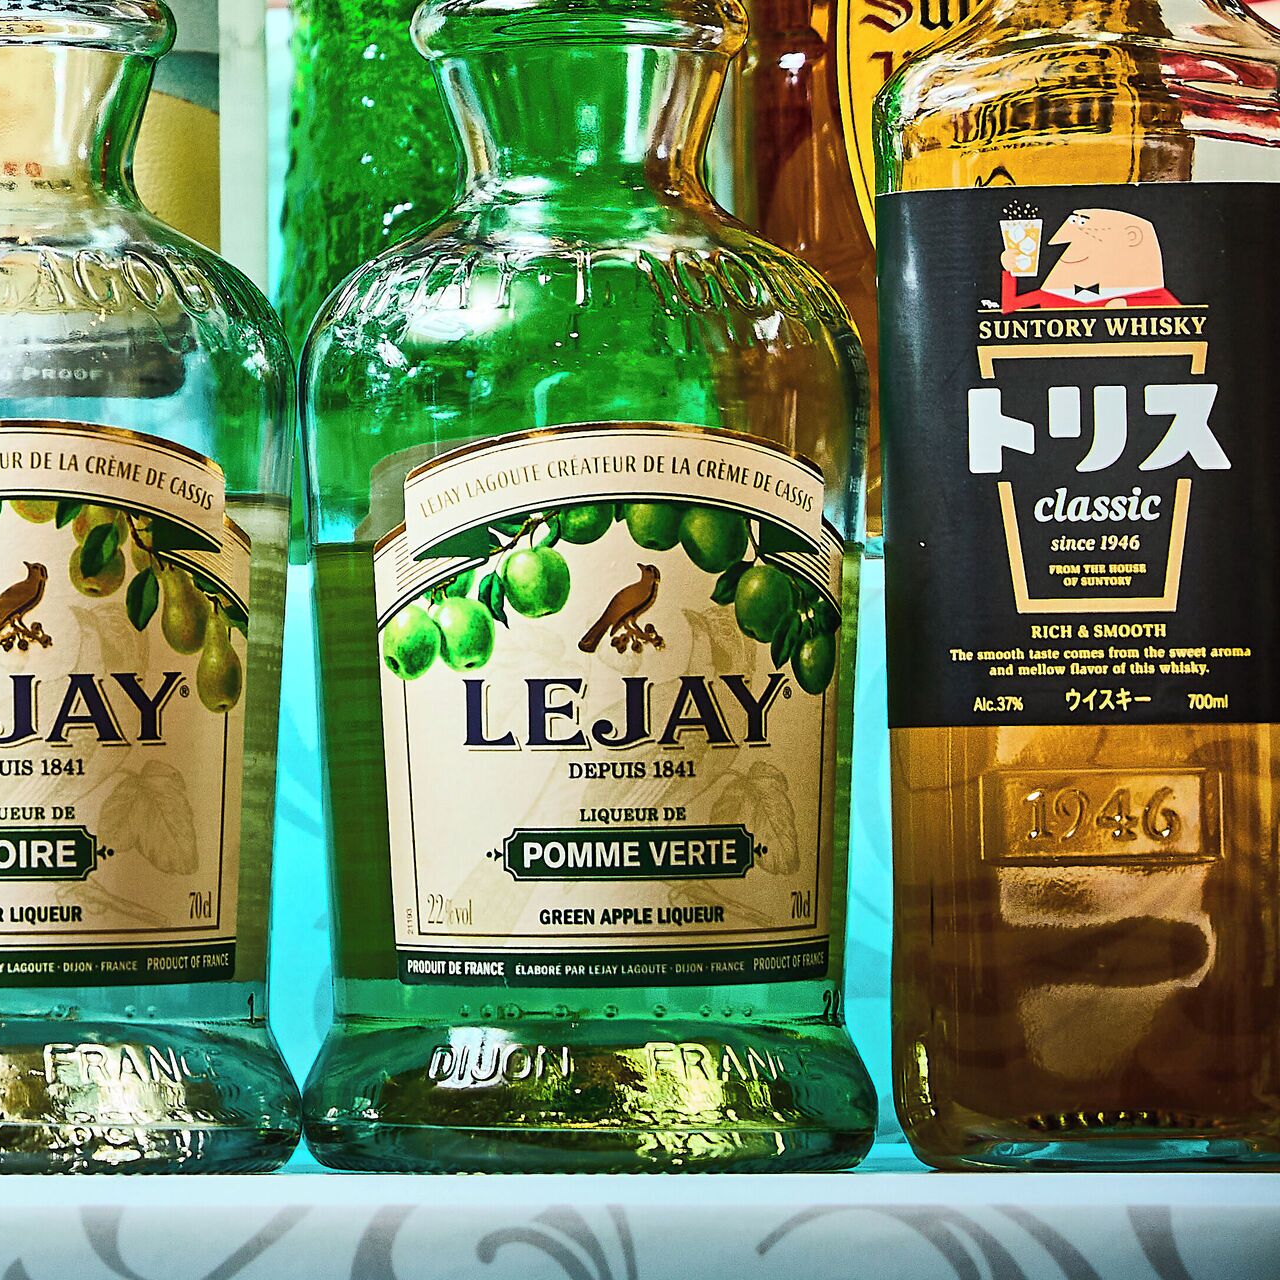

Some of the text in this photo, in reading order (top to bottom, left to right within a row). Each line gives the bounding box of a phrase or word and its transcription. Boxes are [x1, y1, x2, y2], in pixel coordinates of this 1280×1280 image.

[979, 317, 1208, 342] SUNTORY WHISKY
[968, 384, 1231, 474] トリス
[1034, 488, 1162, 522] classic
[1050, 535, 1140, 553] since 1946
[1049, 564, 1146, 574] FROM THE HOUSE
[1063, 577, 1132, 586] OF SUNTORY
[1031, 624, 1166, 639] RICH & SMOOTH
[950, 646, 1251, 662] The smooth taste comes from the sweet aroma
[989, 662, 1209, 676] and mellow flavor of this whisky.
[973, 696, 1023, 712] Alc.37%
[1065, 688, 1151, 711] ウイスキー
[1188, 693, 1229, 710] 700ml
[463, 674, 786, 747] LEJAY
[40, 759, 85, 776] 1841
[569, 761, 696, 780] DEPUIS 1841
[52, 807, 75, 821] DE
[580, 807, 687, 824] LIQUEUR DE
[1022, 785, 1182, 842] 1946
[523, 838, 737, 869] POMME VERTE
[189, 891, 212, 920] 70cl
[9, 906, 83, 923] LIQUEUR
[540, 907, 725, 926] GREEN APPLE LIQUEUR
[7, 961, 55, 974] LAGOUTE
[63, 961, 92, 973] DIJON
[101, 959, 138, 972] FRANCE
[146, 953, 229, 970] PRODUCT OF FRANCE
